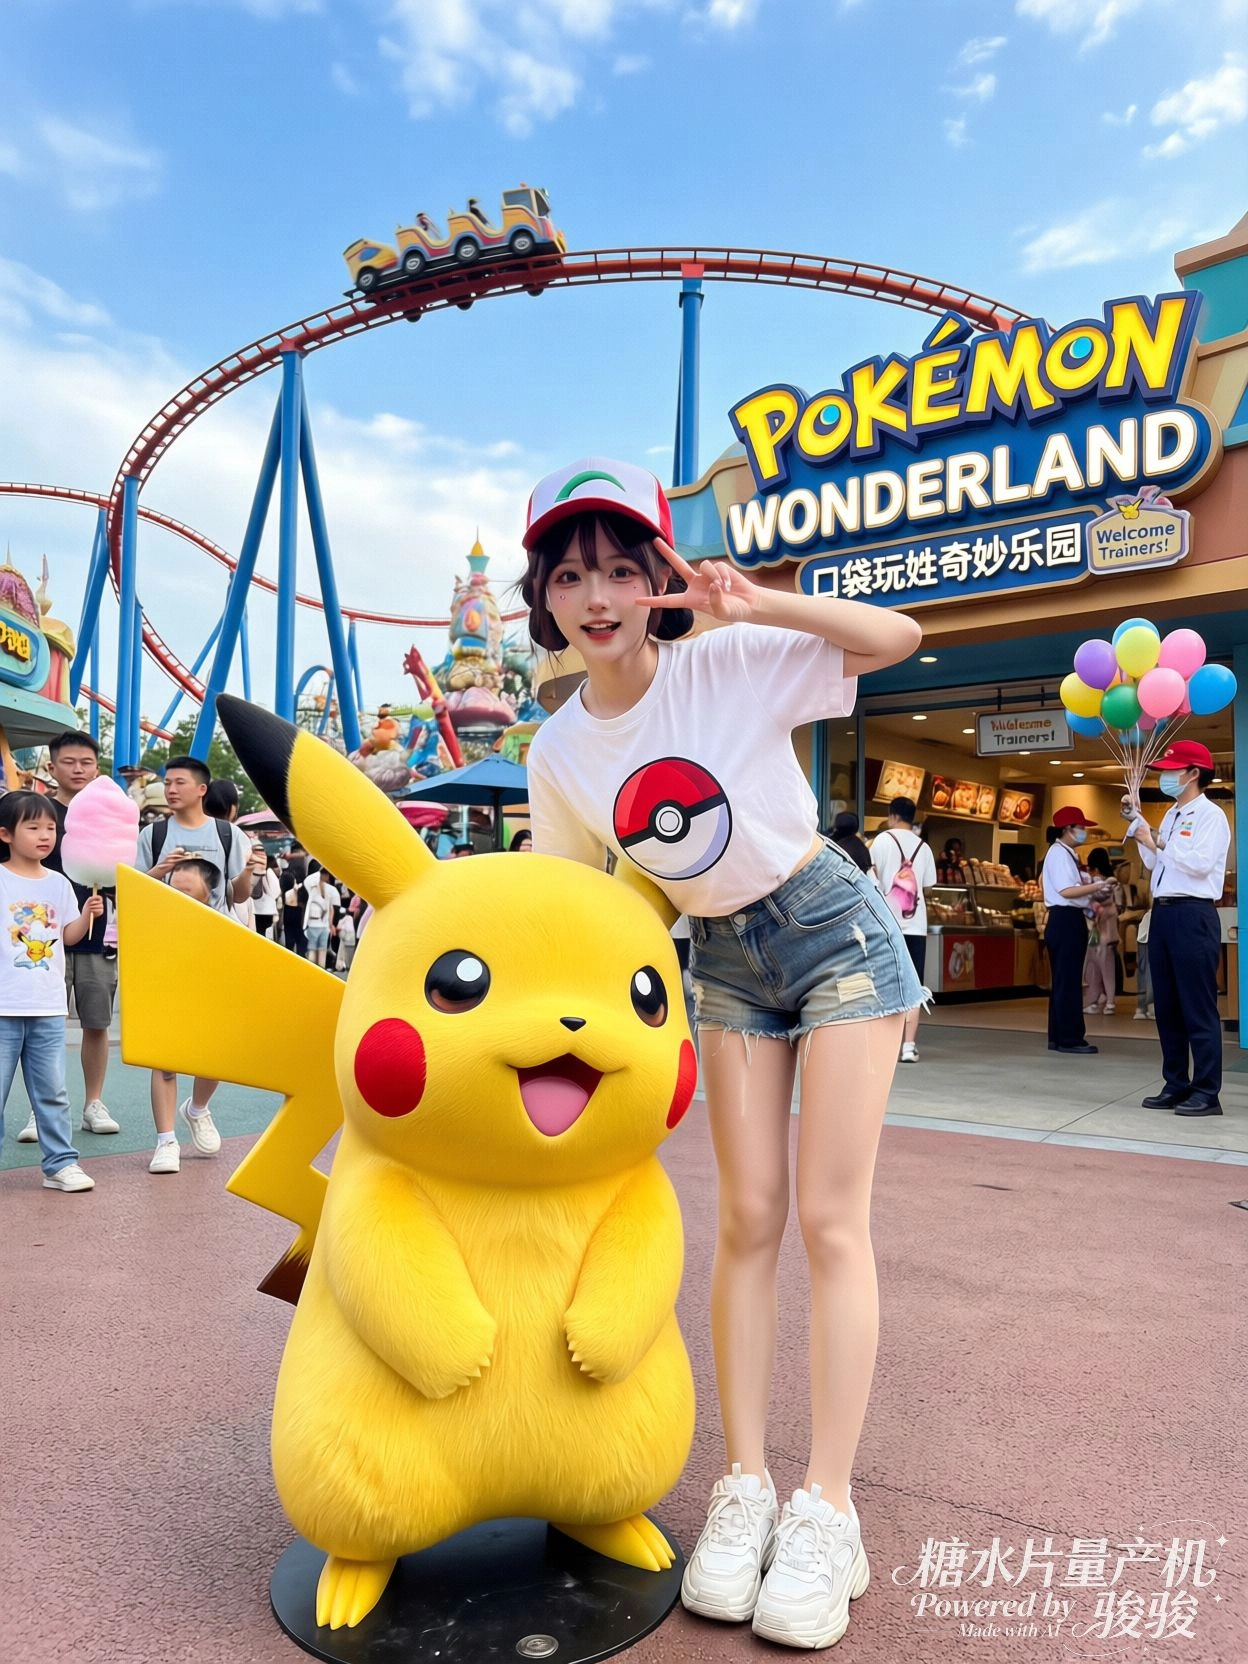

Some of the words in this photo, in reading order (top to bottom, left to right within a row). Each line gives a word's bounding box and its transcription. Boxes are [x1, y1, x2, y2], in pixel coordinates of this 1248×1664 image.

[731, 293, 1195, 488] POKÉMON
[727, 408, 1199, 557] WONDERLAND
[1096, 523, 1176, 544] Welcome
[1098, 538, 1169, 561] Trainers!
[993, 729, 1055, 746] Trainers!
